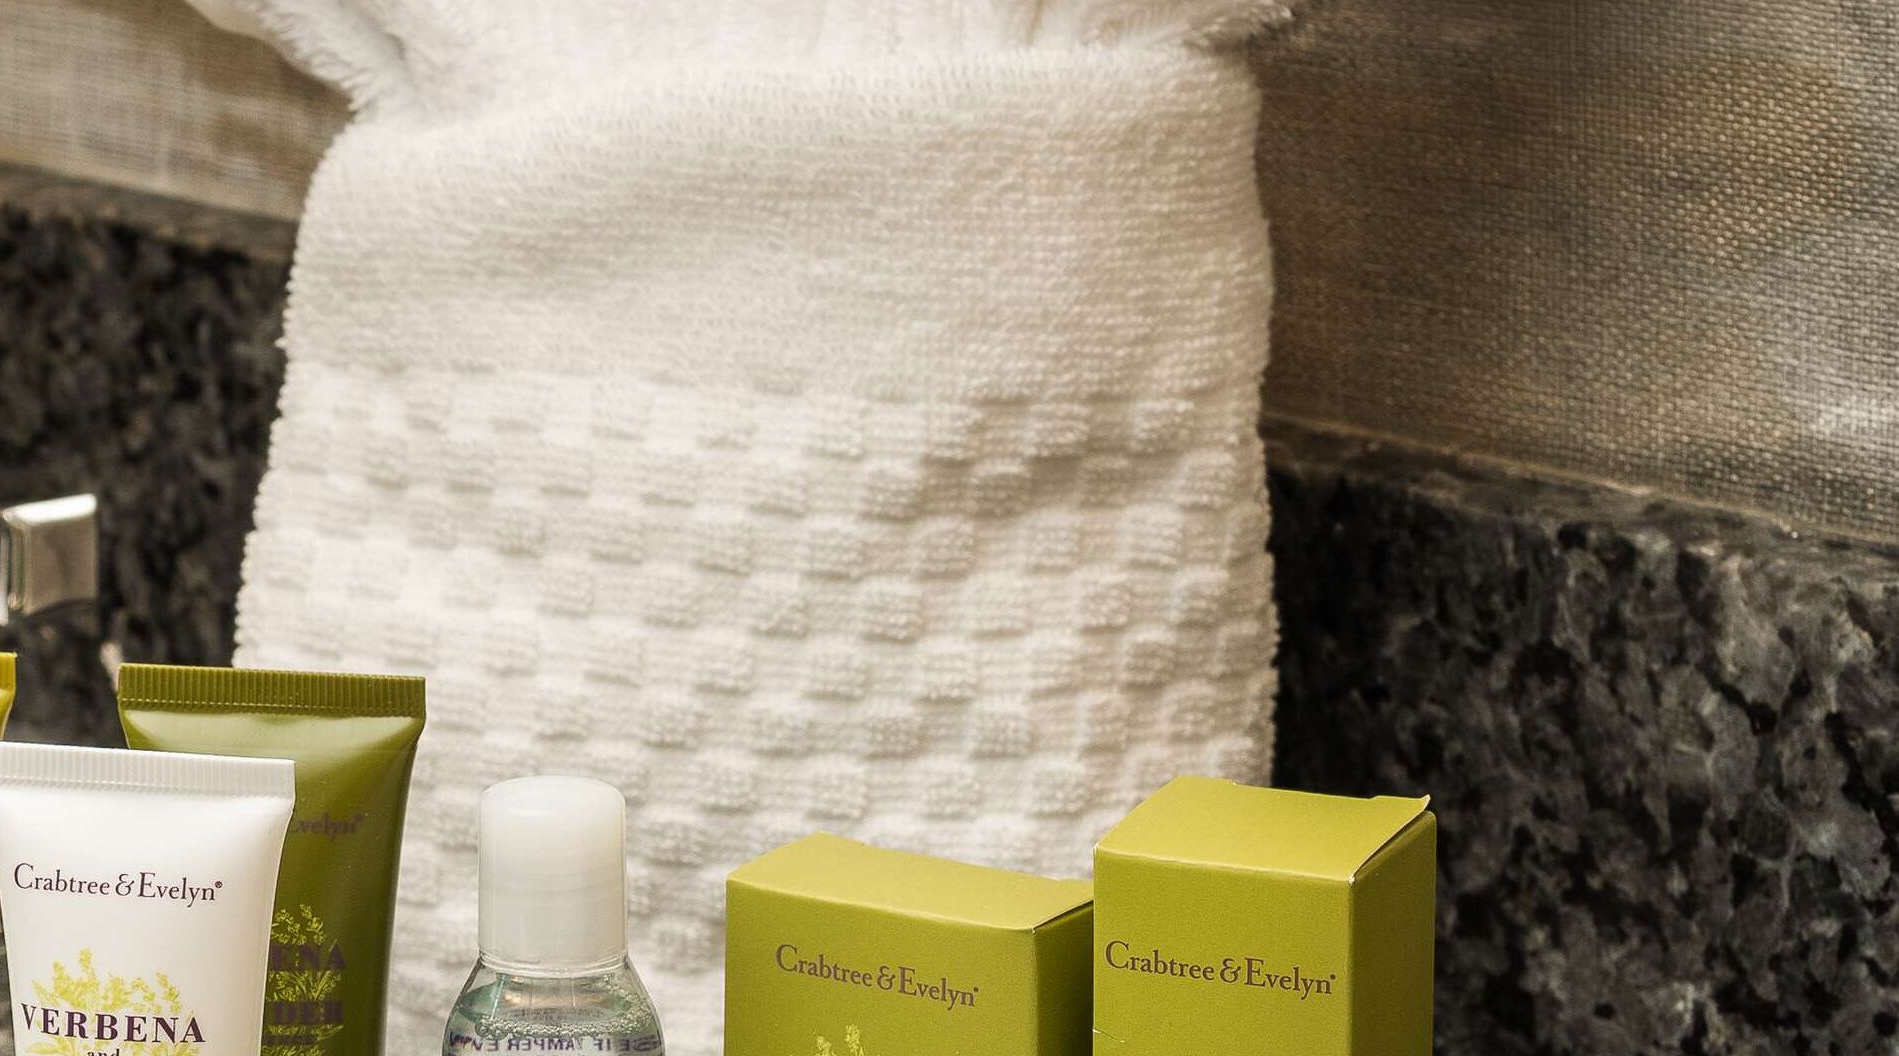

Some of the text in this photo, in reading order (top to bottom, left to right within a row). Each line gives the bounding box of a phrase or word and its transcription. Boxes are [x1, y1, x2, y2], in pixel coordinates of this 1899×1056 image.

[13, 862, 111, 897] Crabtree
[115, 874, 133, 897] &
[775, 944, 873, 989] Crabtree
[877, 965, 896, 991] &
[1105, 940, 1214, 984] Crabtree
[1219, 960, 1242, 983] &
[20, 1002, 206, 1044] VERBENA
